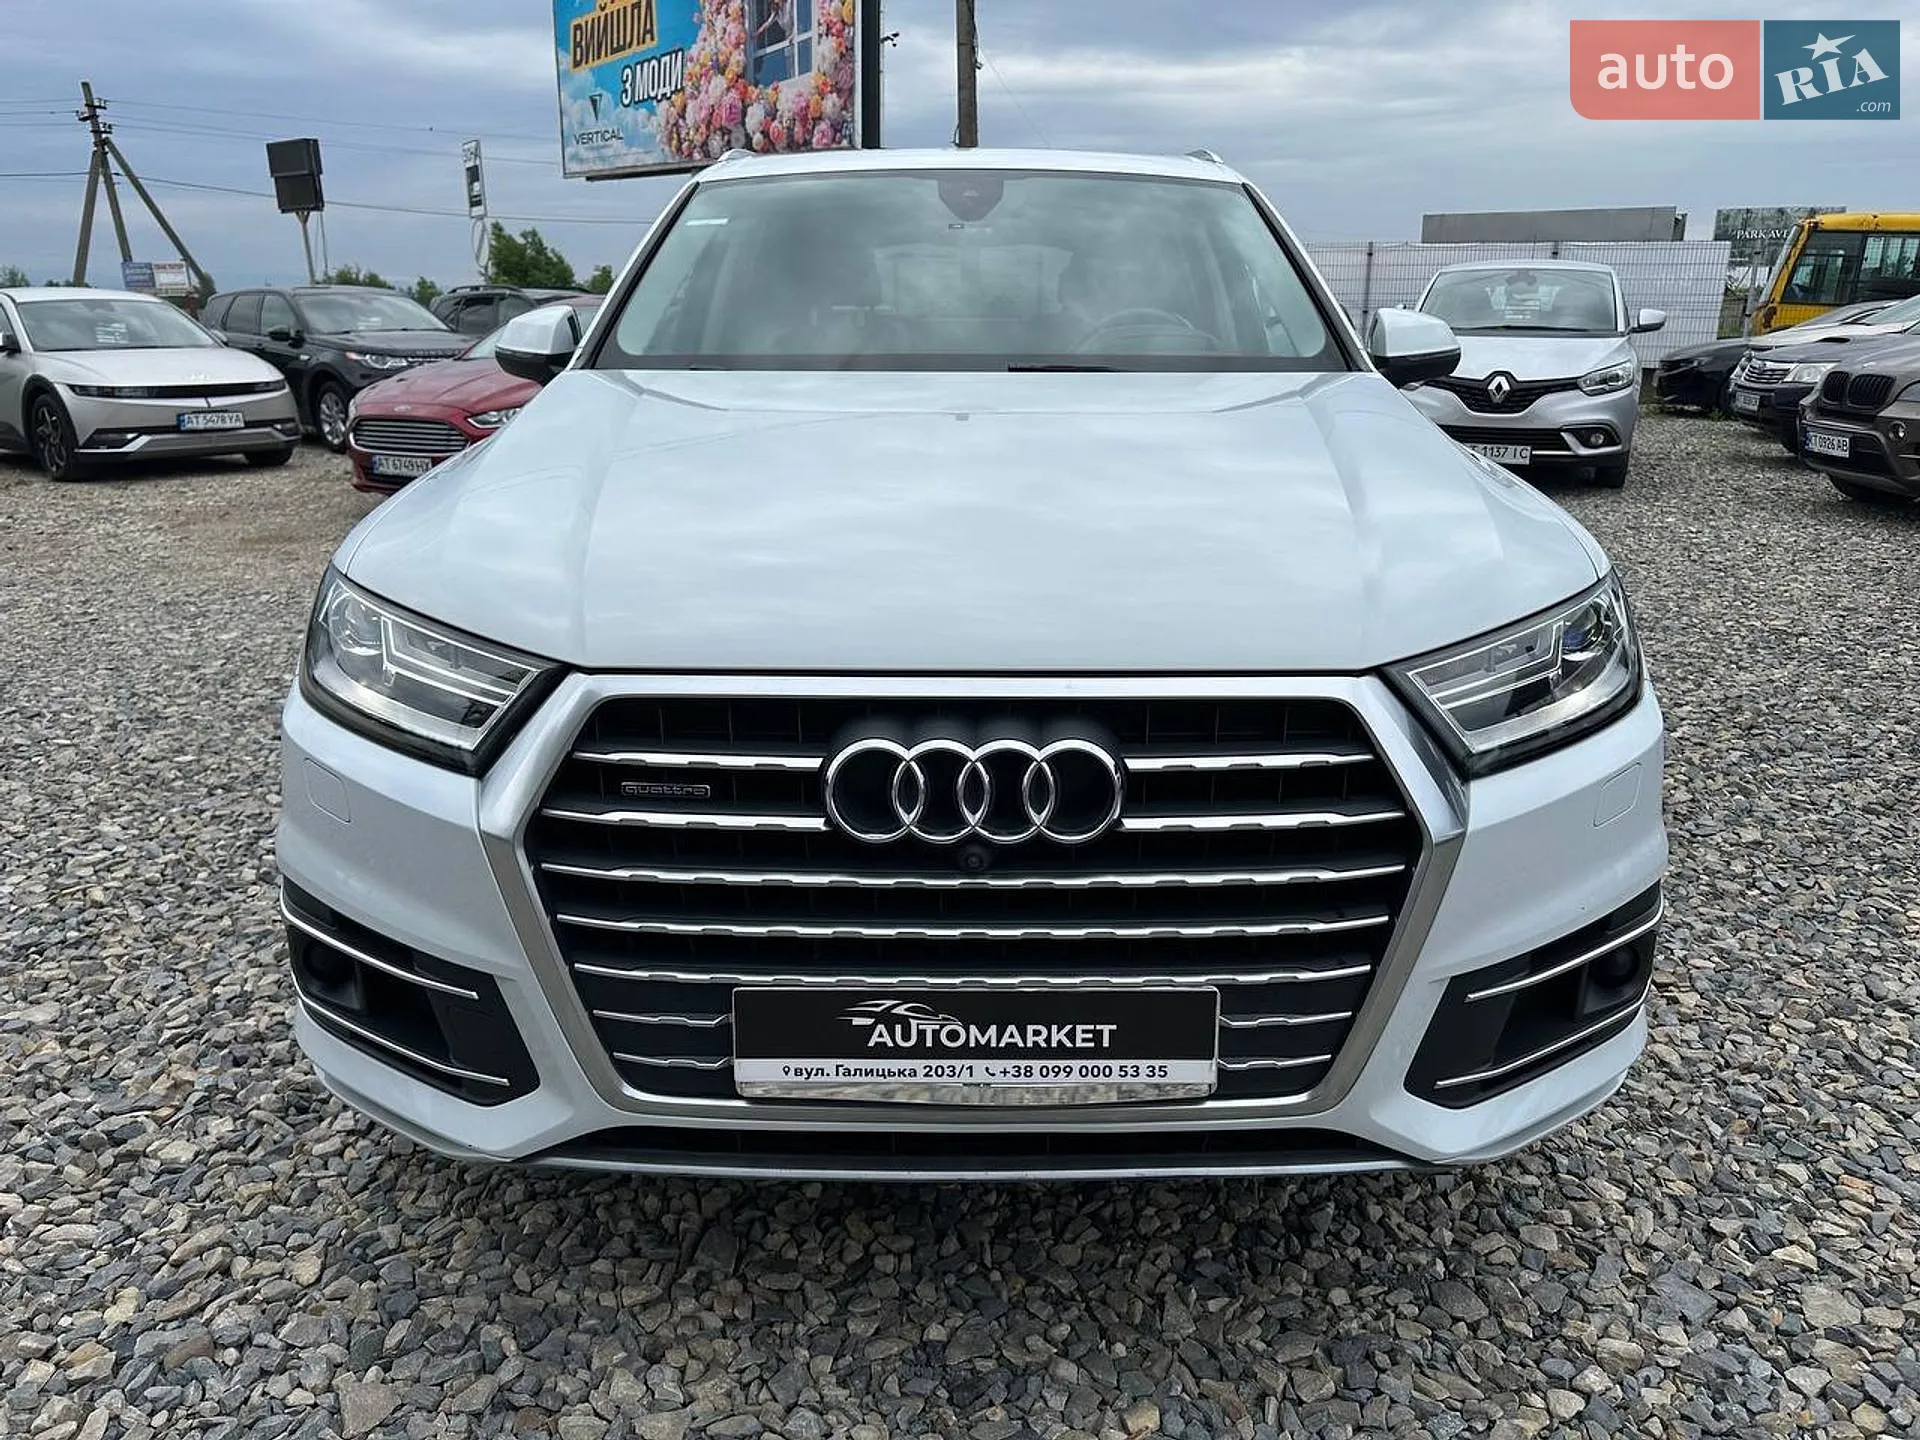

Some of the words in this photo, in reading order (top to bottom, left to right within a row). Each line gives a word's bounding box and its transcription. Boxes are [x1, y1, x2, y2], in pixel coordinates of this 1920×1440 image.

[634, 49, 683, 102] МОДИ
[573, 128, 624, 145] VERTICAL
[1736, 230, 1767, 239] PARK
[187, 415, 200, 426] AT
[1481, 445, 1509, 458] 1137
[625, 786, 706, 795] quattro
[867, 1023, 1118, 1048] AUTOMARKET
[794, 1067, 830, 1080] вул.
[835, 1064, 918, 1080] Галицька
[922, 1064, 975, 1079] 203/1
[1000, 1065, 1034, 1079] +38
[1039, 1065, 1074, 1079] 099
[1078, 1065, 1113, 1079] 000
[1118, 1065, 1141, 1079] 53
[1145, 1065, 1169, 1079] 35
